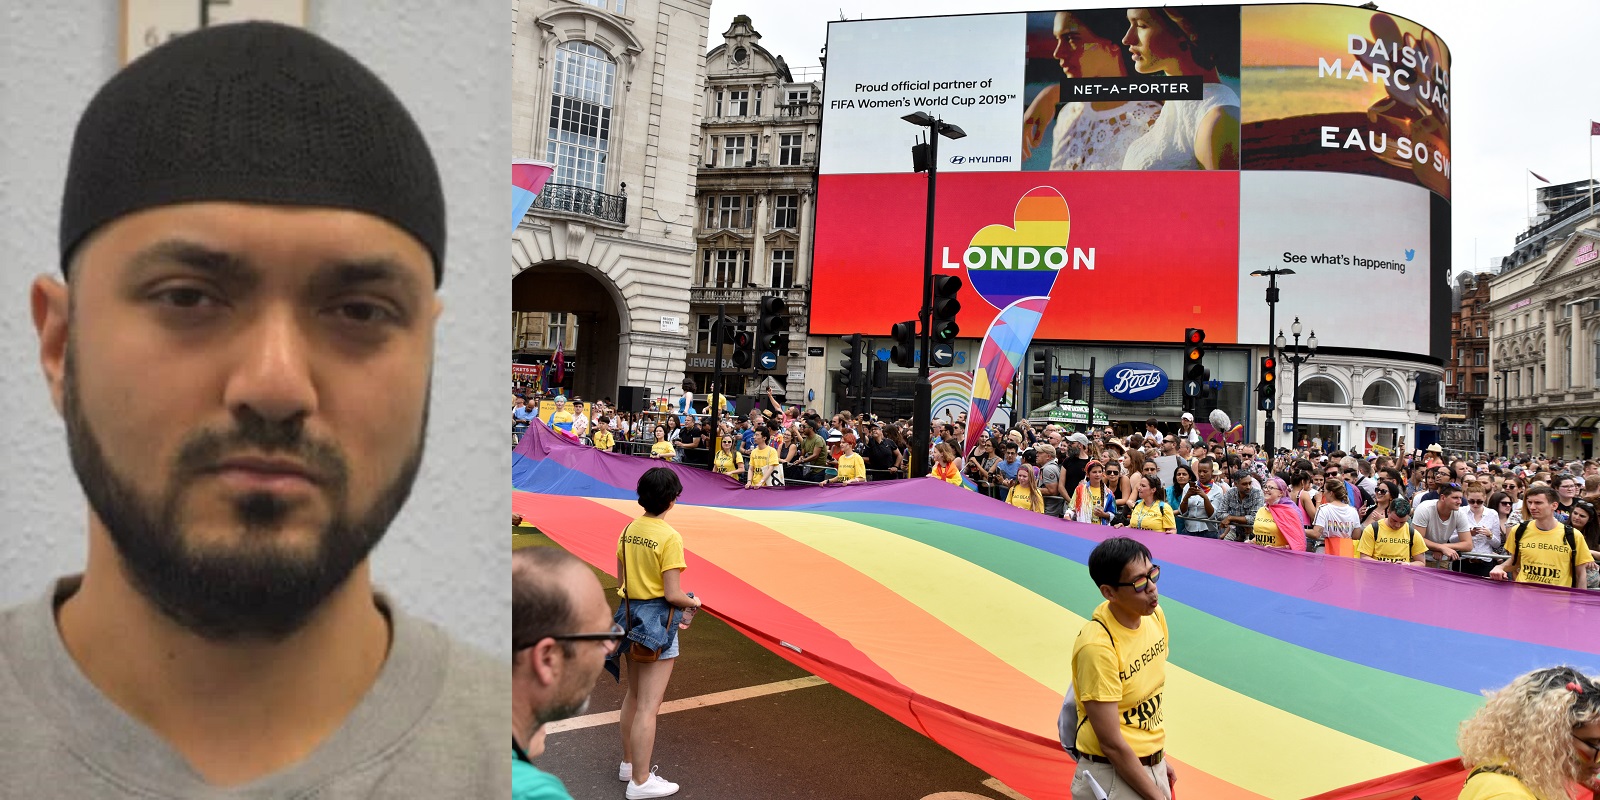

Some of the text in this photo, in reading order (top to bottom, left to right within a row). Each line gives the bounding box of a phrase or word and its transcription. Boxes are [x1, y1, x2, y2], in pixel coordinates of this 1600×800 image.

[1347, 33, 1429, 73] DAISY
[1318, 57, 1411, 91] MARC
[855, 78, 992, 93] Proud official partner of
[1073, 83, 1190, 95] NET-A-PORTER
[830, 100, 855, 109] FIFA
[857, 96, 911, 108] Women's
[913, 95, 948, 106] World
[951, 95, 976, 107] Cup
[1321, 125, 1387, 154] EAU
[1396, 137, 1429, 164] SO
[968, 155, 1012, 164] HYUNDAI
[941, 246, 1096, 271] LONDON
[1283, 251, 1406, 274] See what's happening
[1109, 368, 1161, 394] Boots
[632, 535, 659, 550] BEARER
[1255, 534, 1276, 544] RIDE
[1389, 537, 1410, 545] BEARE
[1538, 542, 1570, 554] BEARER
[1523, 564, 1561, 579] PRIDE
[1119, 658, 1141, 682] FLAG
